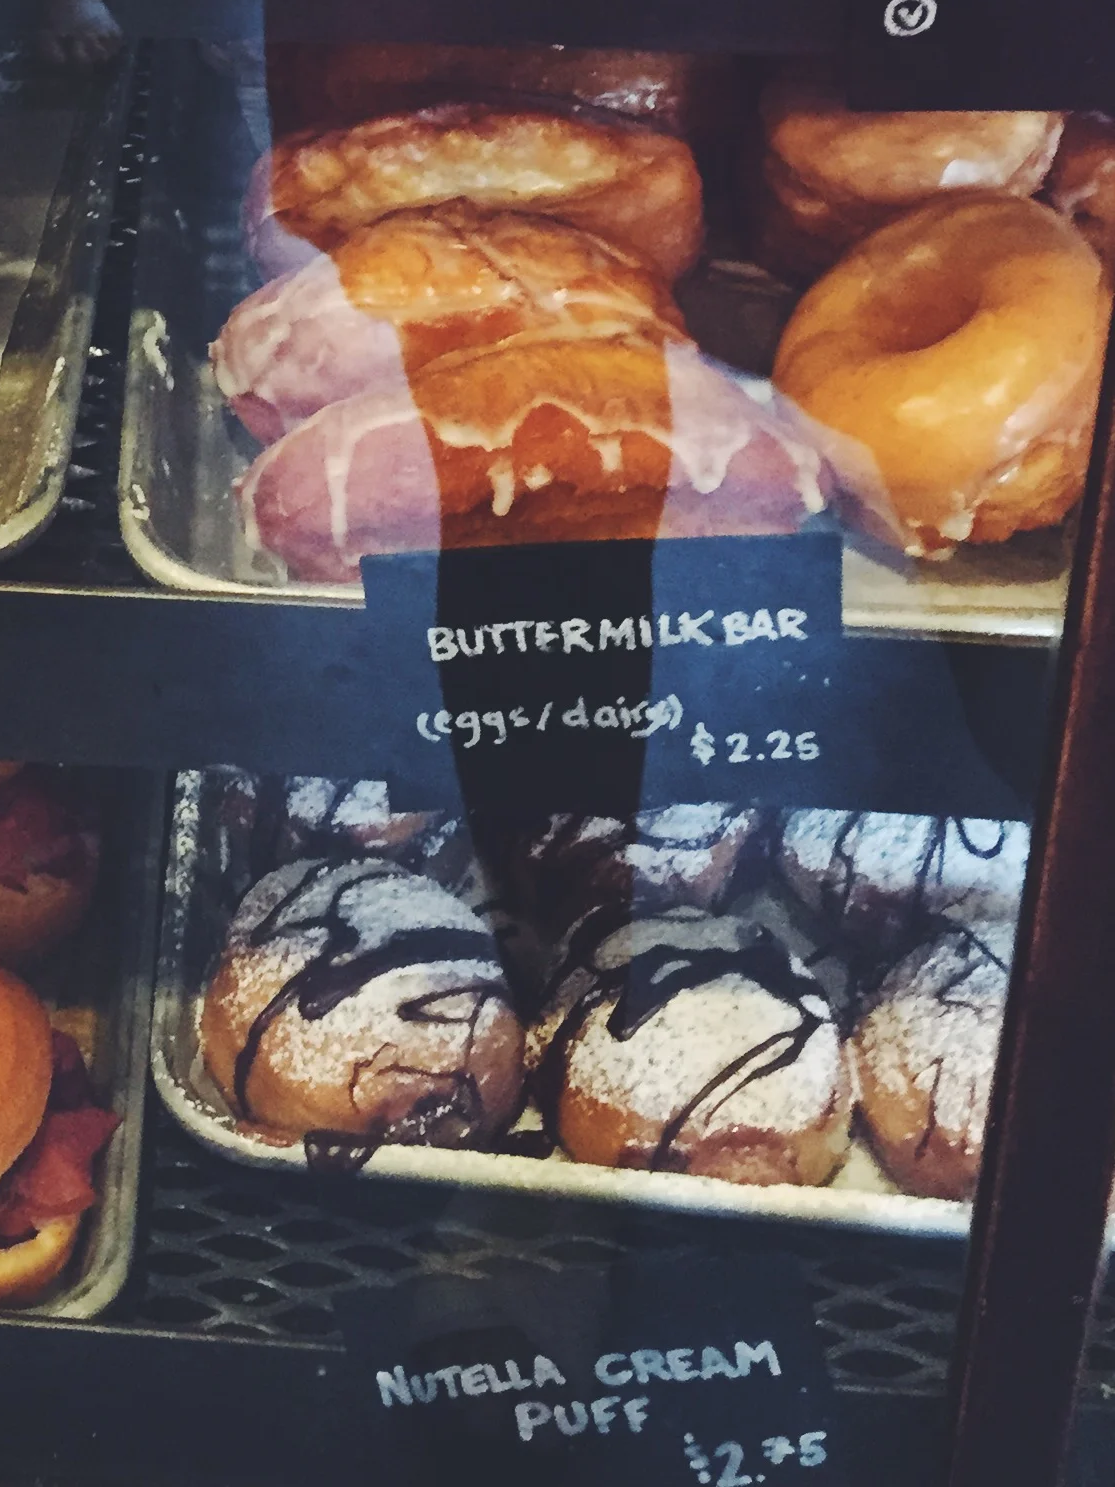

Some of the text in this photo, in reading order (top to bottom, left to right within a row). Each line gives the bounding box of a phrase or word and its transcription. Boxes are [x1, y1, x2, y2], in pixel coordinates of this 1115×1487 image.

[427, 608, 808, 661] BUTTERMILK BAR
[690, 722, 821, 765] $2.25
[376, 1341, 782, 1407] NUTELLA CREAM
[515, 1395, 650, 1442] PUFF
